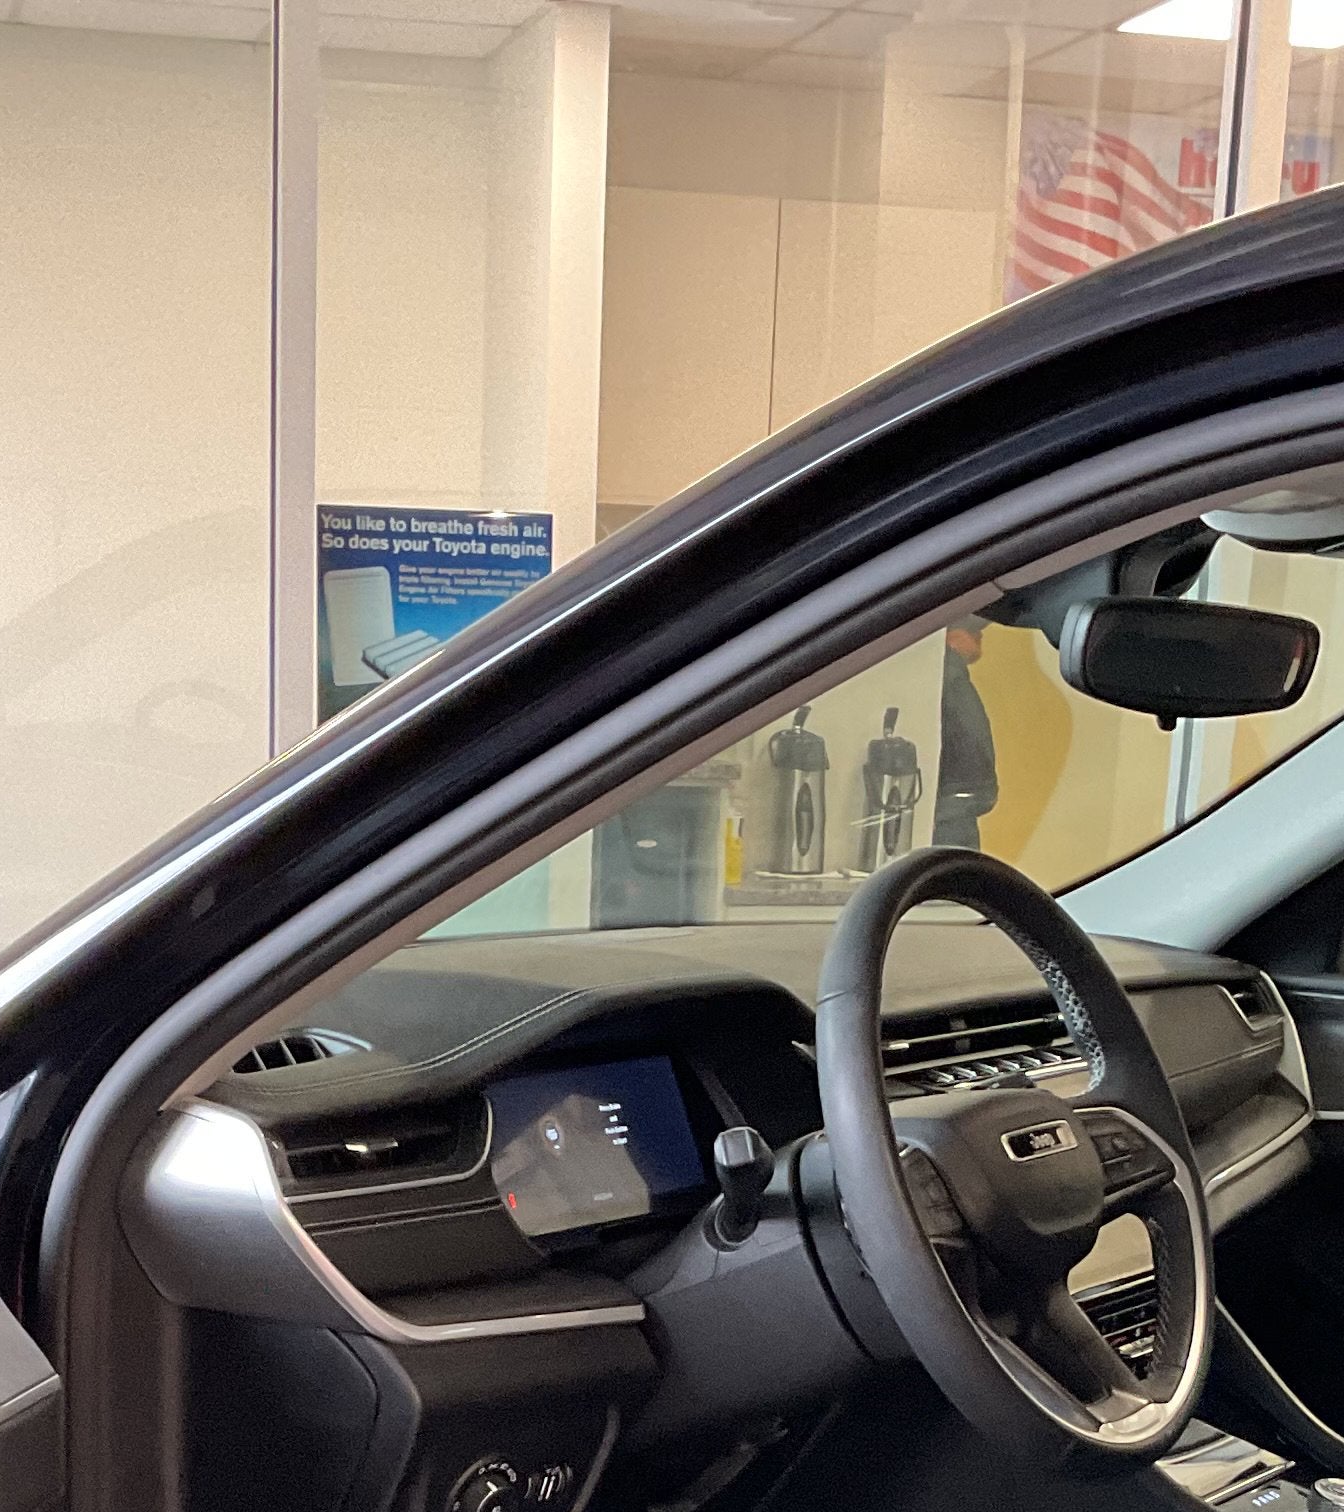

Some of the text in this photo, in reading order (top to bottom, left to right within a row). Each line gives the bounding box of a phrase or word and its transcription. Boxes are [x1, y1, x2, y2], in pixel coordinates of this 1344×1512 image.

[321, 513, 548, 538] You like to breathe fresh air.
[321, 533, 550, 559] So does your Toyota engine.
